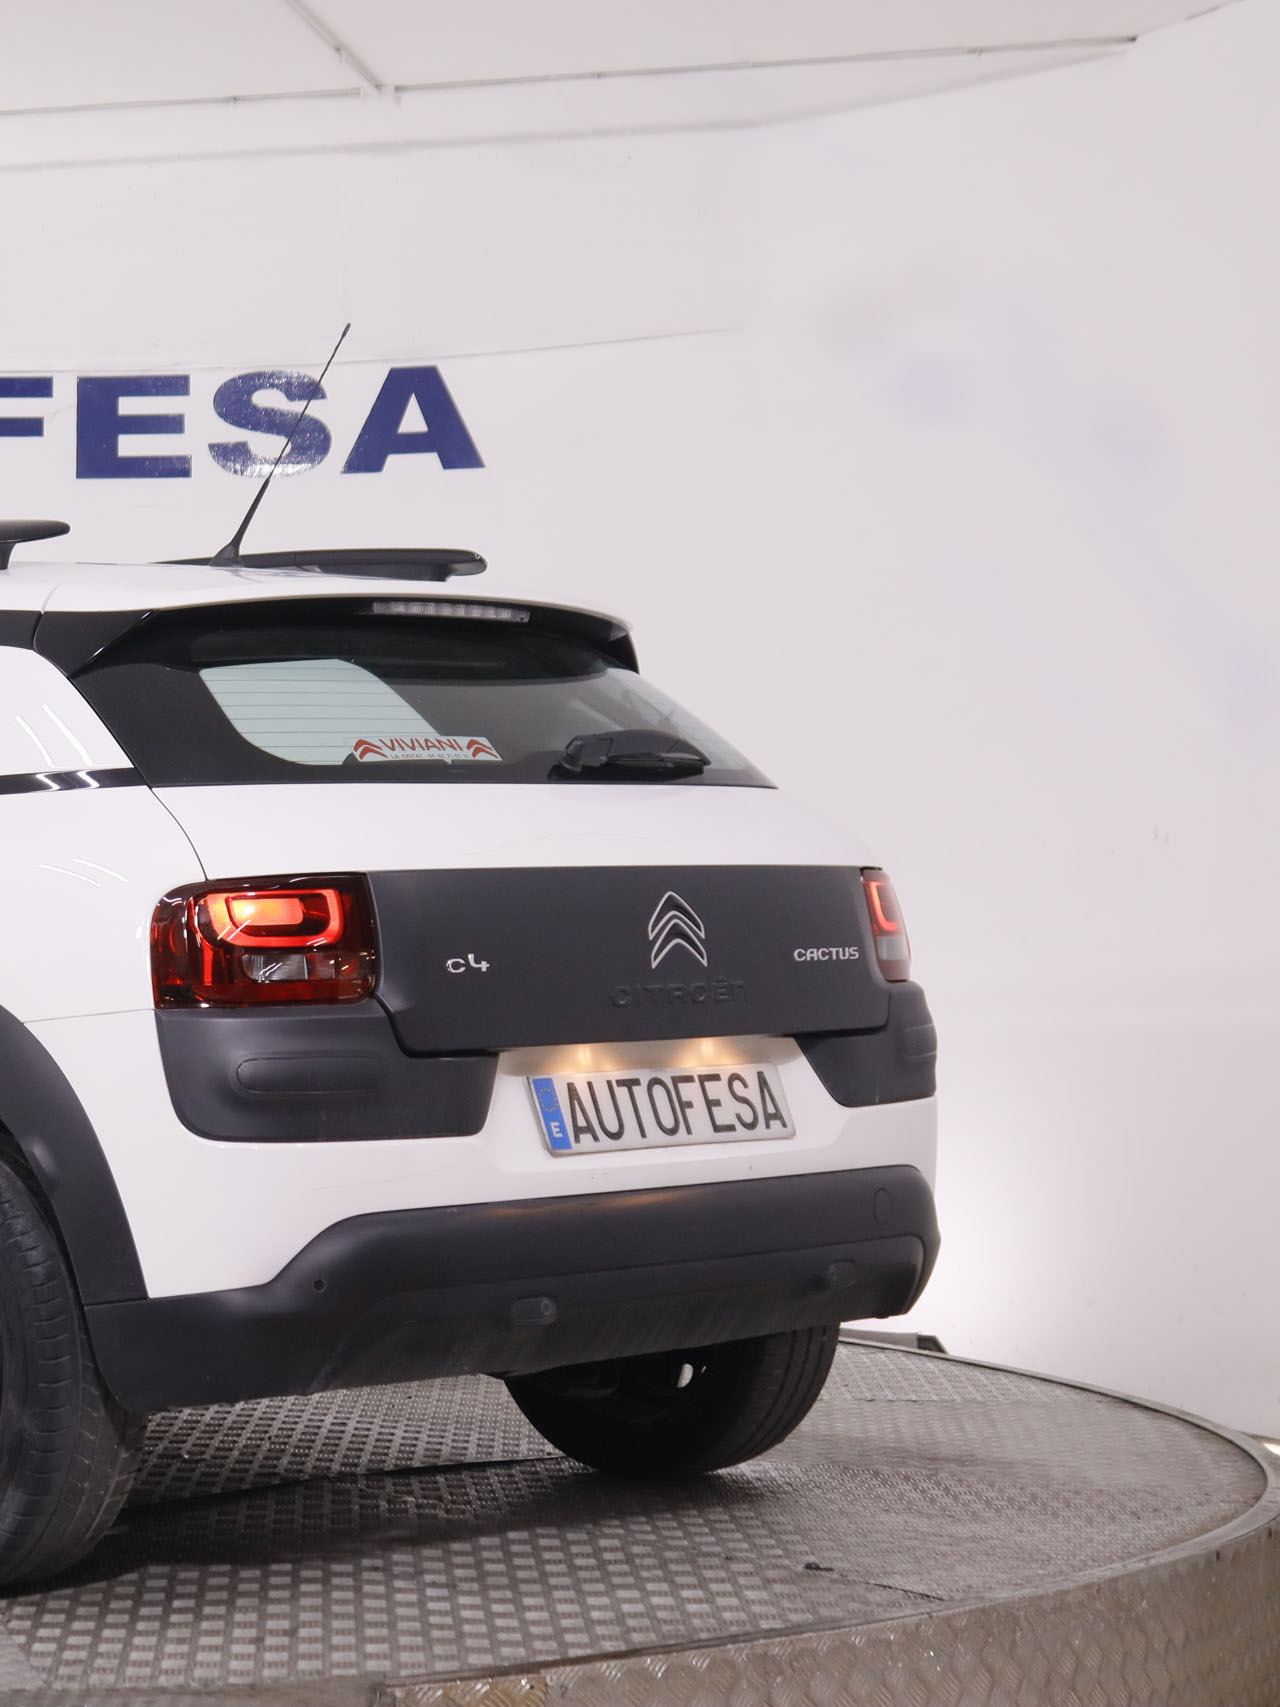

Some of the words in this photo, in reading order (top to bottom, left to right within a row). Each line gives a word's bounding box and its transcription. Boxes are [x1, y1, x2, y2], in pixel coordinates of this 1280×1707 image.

[379, 738, 464, 751] VIVIANI
[793, 946, 860, 962] CACTUS
[567, 1070, 787, 1144] AUTOFESA
[550, 1121, 563, 1138] E
